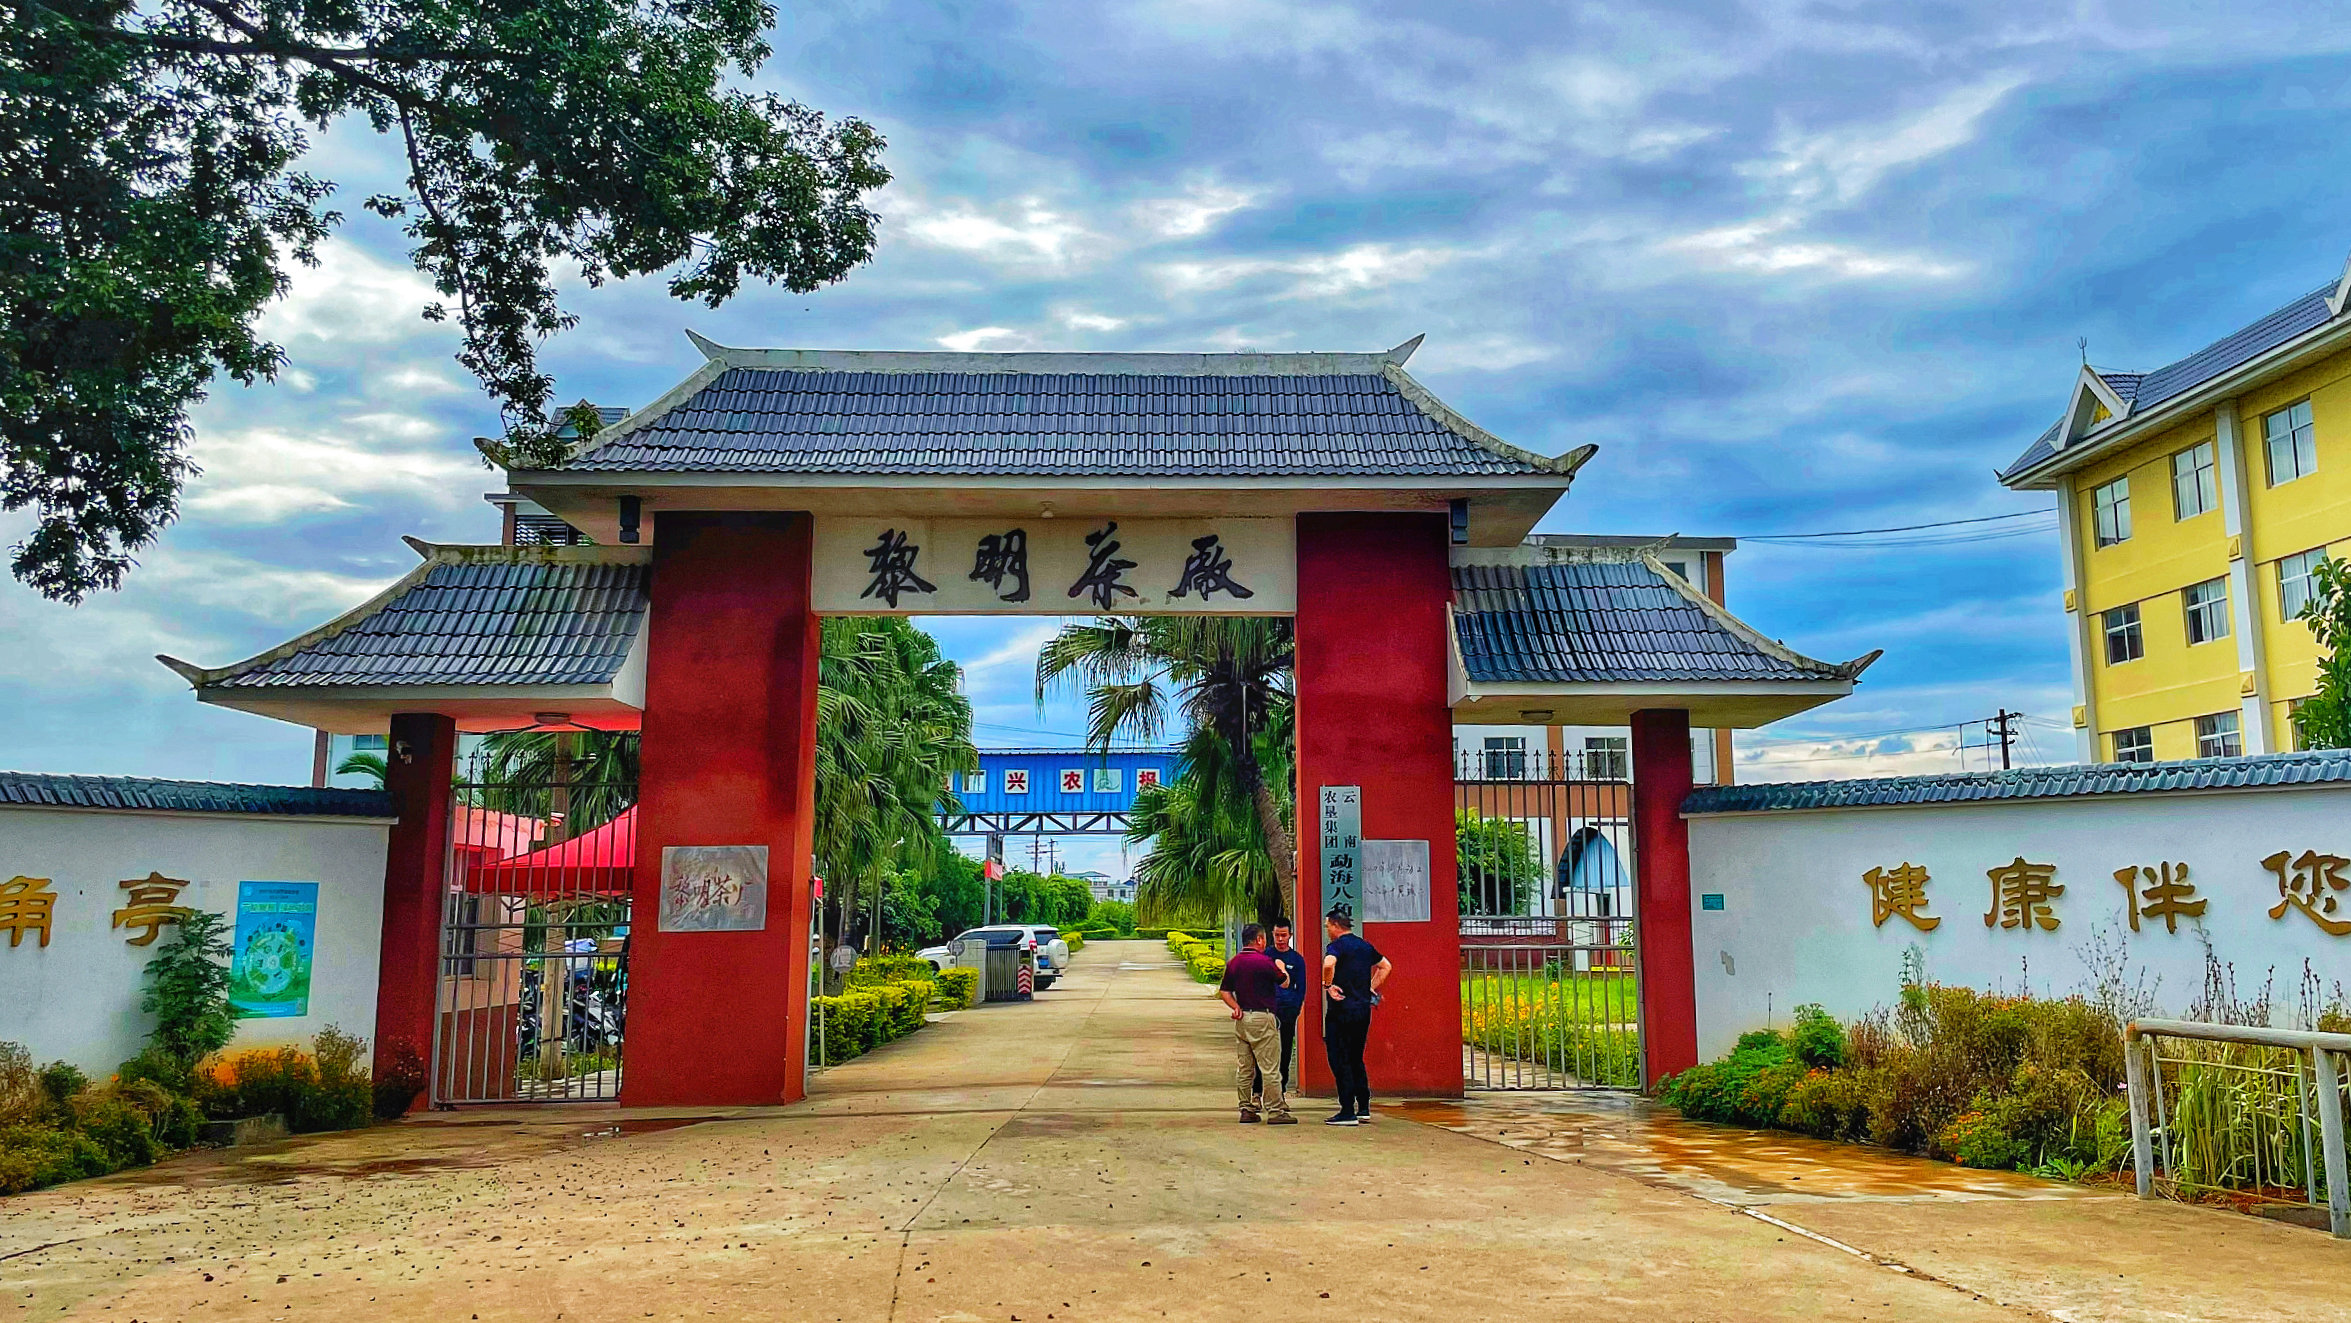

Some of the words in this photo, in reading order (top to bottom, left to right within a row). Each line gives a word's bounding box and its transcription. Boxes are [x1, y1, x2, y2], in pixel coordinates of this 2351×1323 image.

[1324, 790, 1338, 849] 农垦集团
[0, 871, 196, 947] 角亭
[1329, 853, 1355, 928] 勐海八
[1863, 849, 2351, 936] 健康伴您
